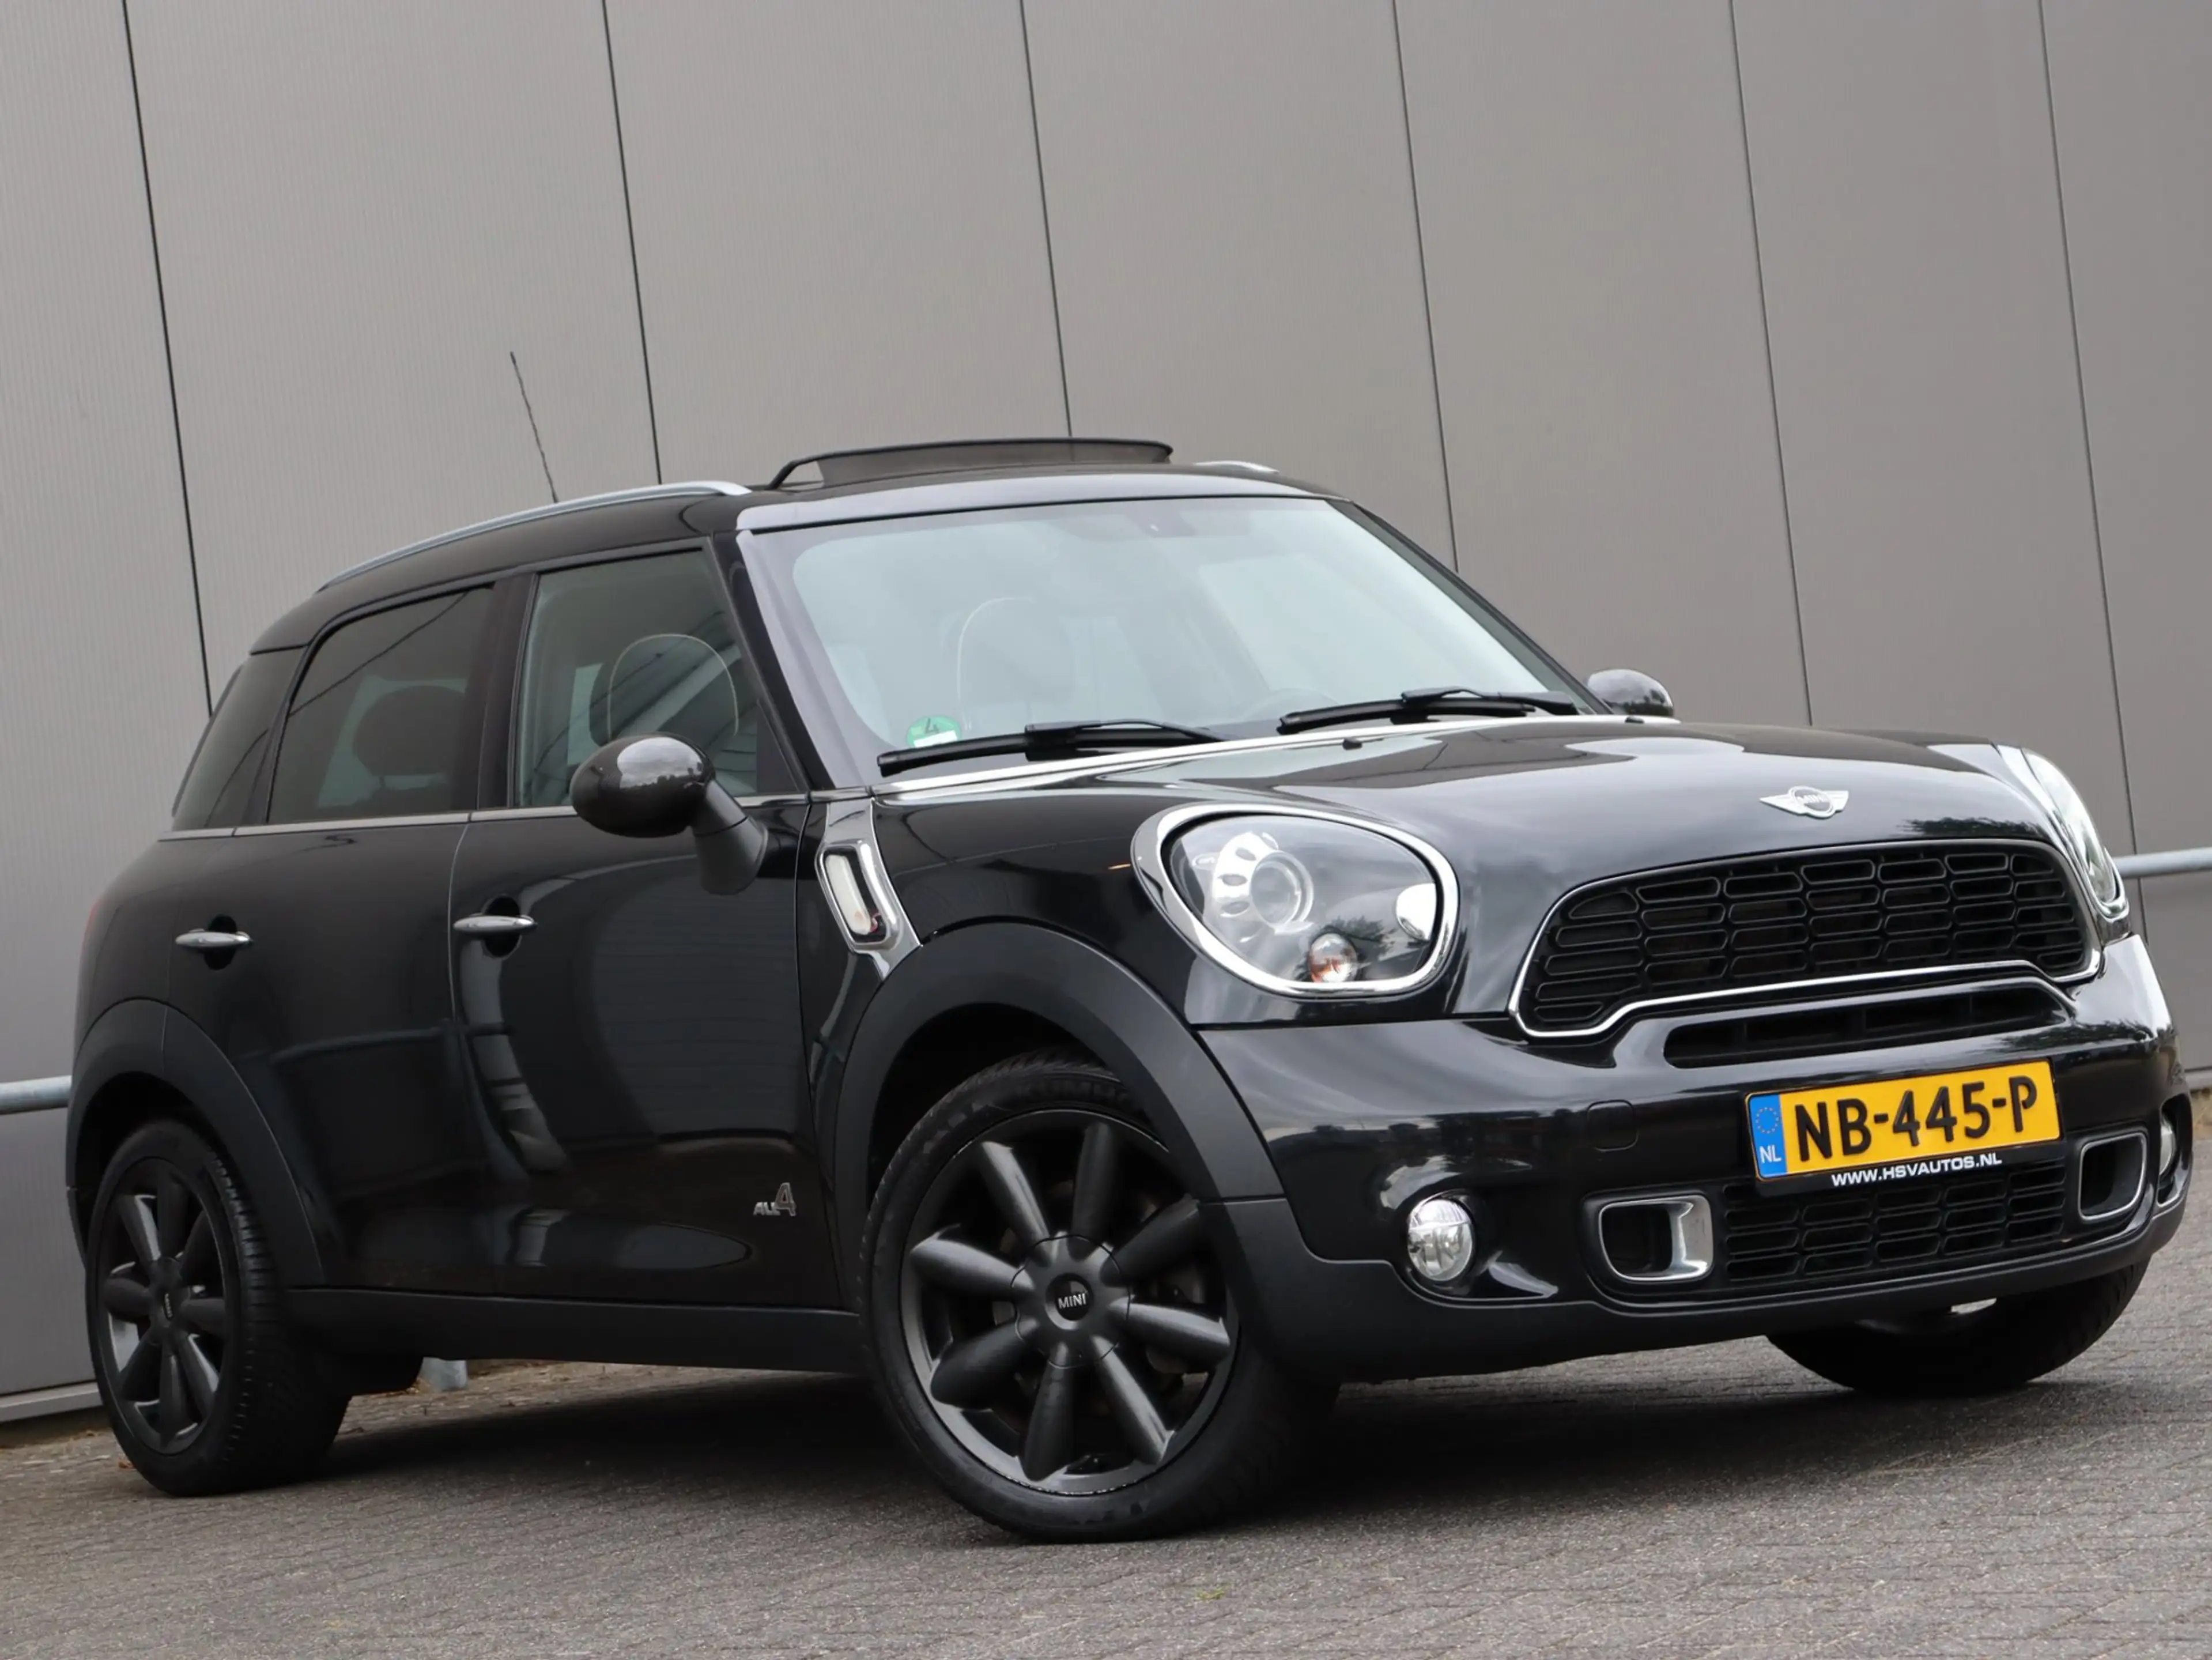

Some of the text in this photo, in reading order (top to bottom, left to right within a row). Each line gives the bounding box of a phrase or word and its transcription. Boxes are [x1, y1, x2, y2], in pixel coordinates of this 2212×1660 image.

[1794, 1076, 2037, 1162] NB-445-P
[1760, 1145, 1782, 1163] NL
[1832, 1153, 2002, 1187] WWW.HSVAUTOS.NL
[1058, 1293, 1086, 1309] MINI
